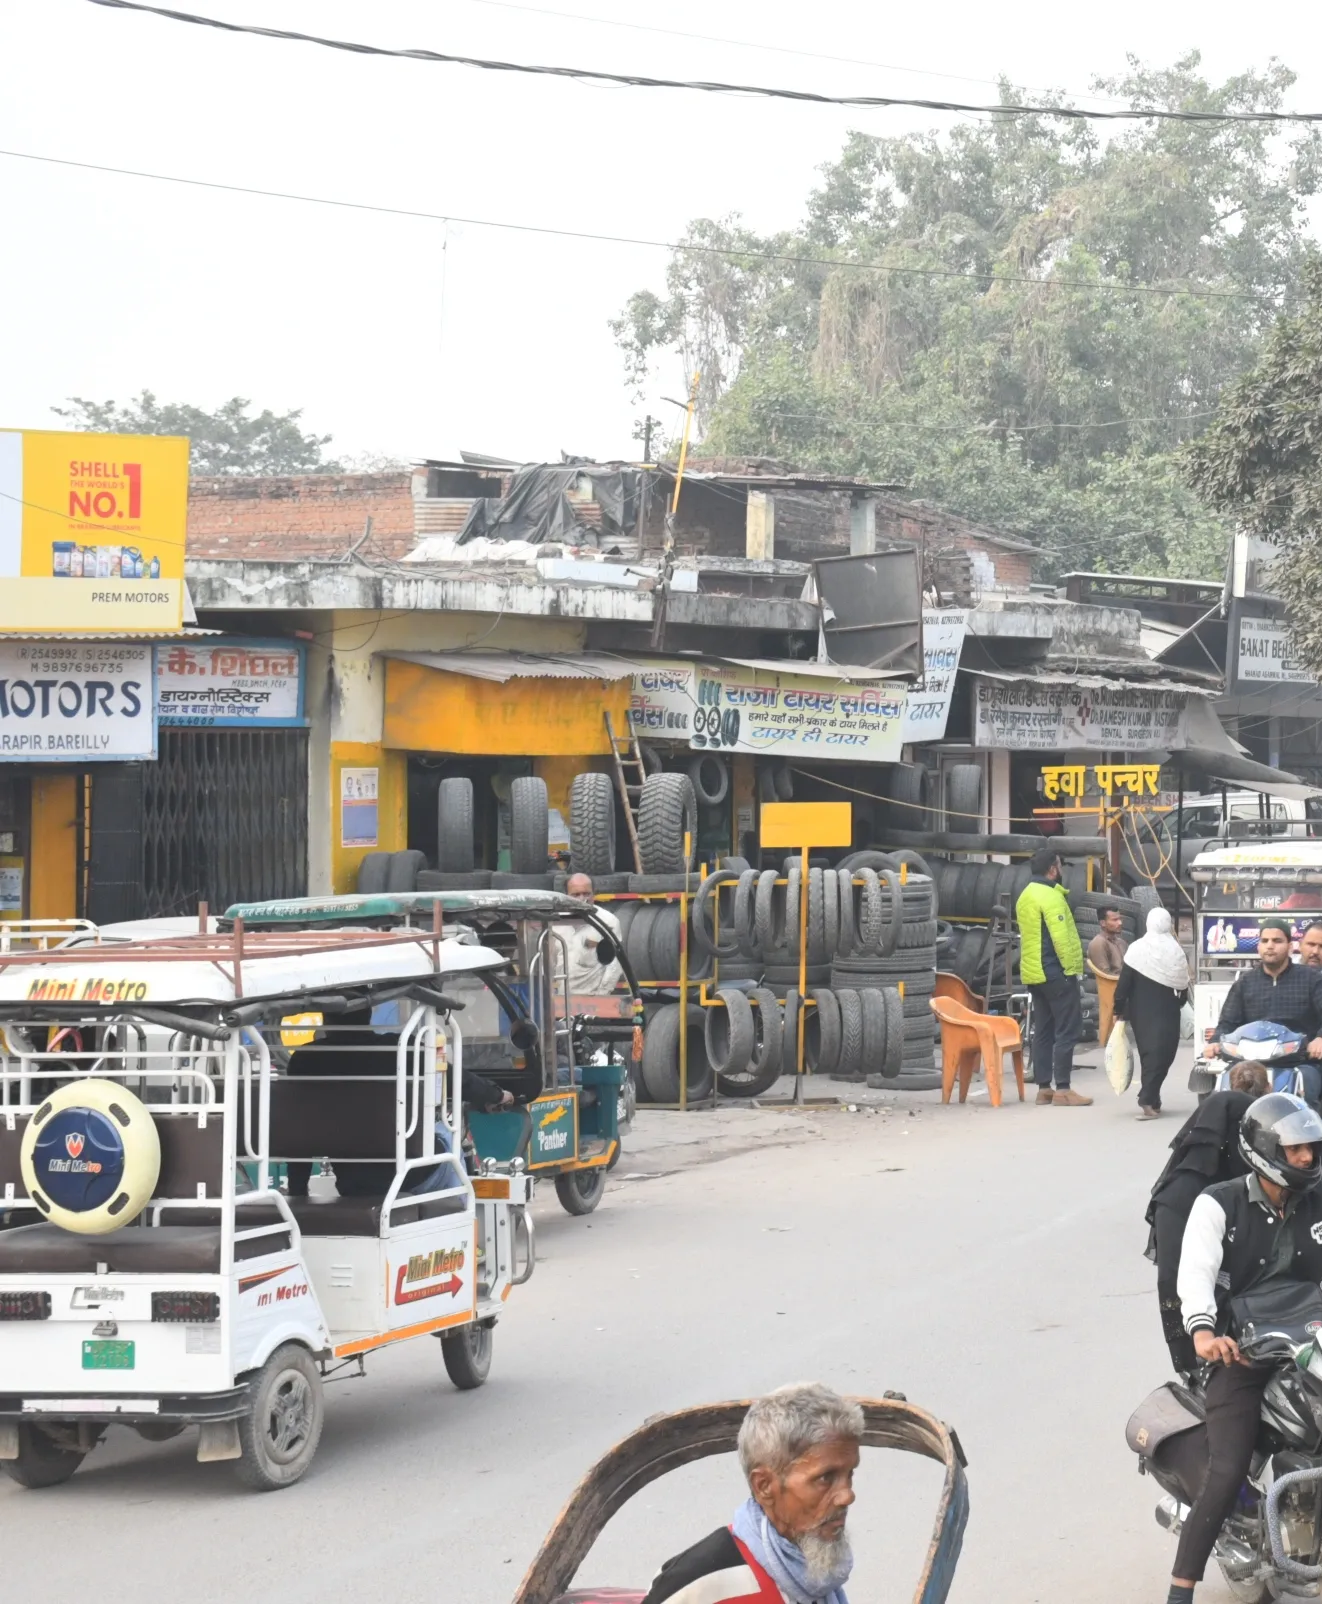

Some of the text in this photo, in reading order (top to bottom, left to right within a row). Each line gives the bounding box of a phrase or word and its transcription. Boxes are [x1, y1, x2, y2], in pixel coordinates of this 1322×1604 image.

[70, 461, 119, 478] SHELL
[70, 480, 84, 488] THE
[123, 463, 142, 518] 1
[92, 592, 170, 603] PREM MOTORS
[1240, 637, 1270, 658] SAKAT
[725, 683, 902, 719] राजा टायर सर्विस
[748, 711, 769, 722] हमारे
[829, 716, 837, 727] के
[839, 719, 857, 729] टायर
[858, 718, 880, 731] मिलते
[881, 721, 888, 732] है
[48, 734, 110, 750] BAREILLY
[752, 726, 870, 747] टायर ही टायर
[1041, 764, 1161, 801] हवा पन्चर
[1254, 897, 1281, 909] HOME
[28, 978, 147, 1001] Mini Metro
[48, 1158, 102, 1174] Mini Metro
[406, 1247, 465, 1284] Mini Metro
[276, 1284, 308, 1302] Metro
[407, 1284, 446, 1300] original
